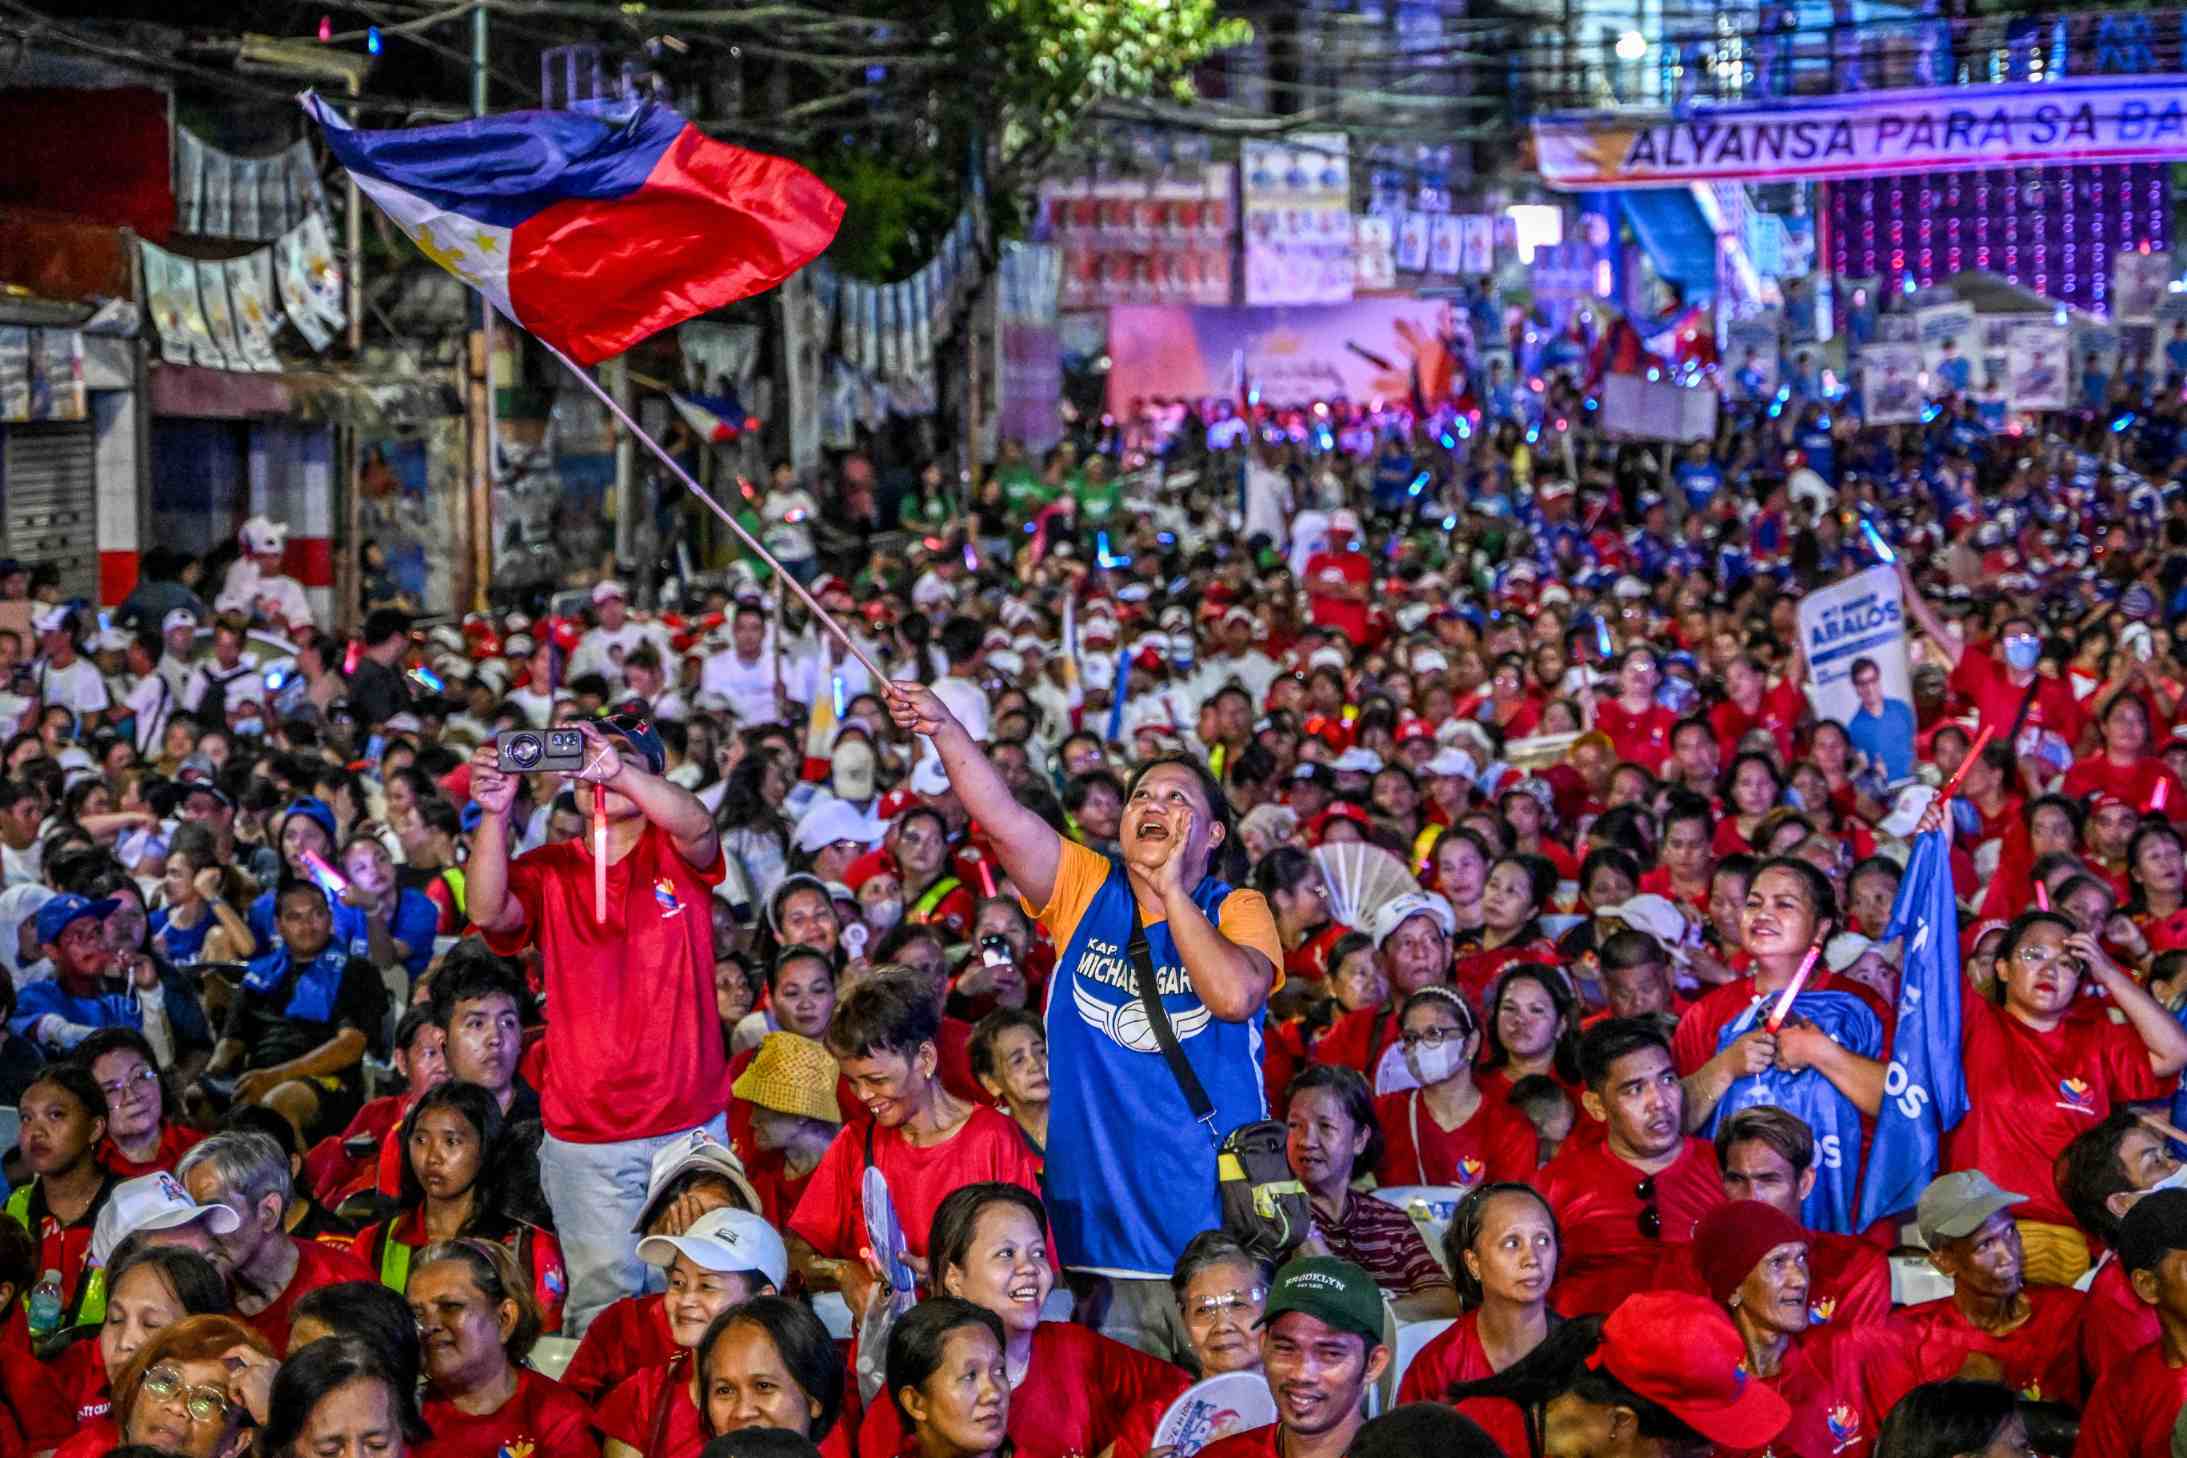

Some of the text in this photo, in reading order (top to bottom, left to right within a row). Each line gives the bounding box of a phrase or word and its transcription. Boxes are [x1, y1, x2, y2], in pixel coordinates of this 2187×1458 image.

[1626, 119, 1855, 167] ALYANSA
[1874, 107, 2012, 152] PARA
[2030, 101, 2096, 142] SA
[1076, 951, 1194, 999] MICHAE GAR
[1284, 1272, 1346, 1292] BROOKLYN
